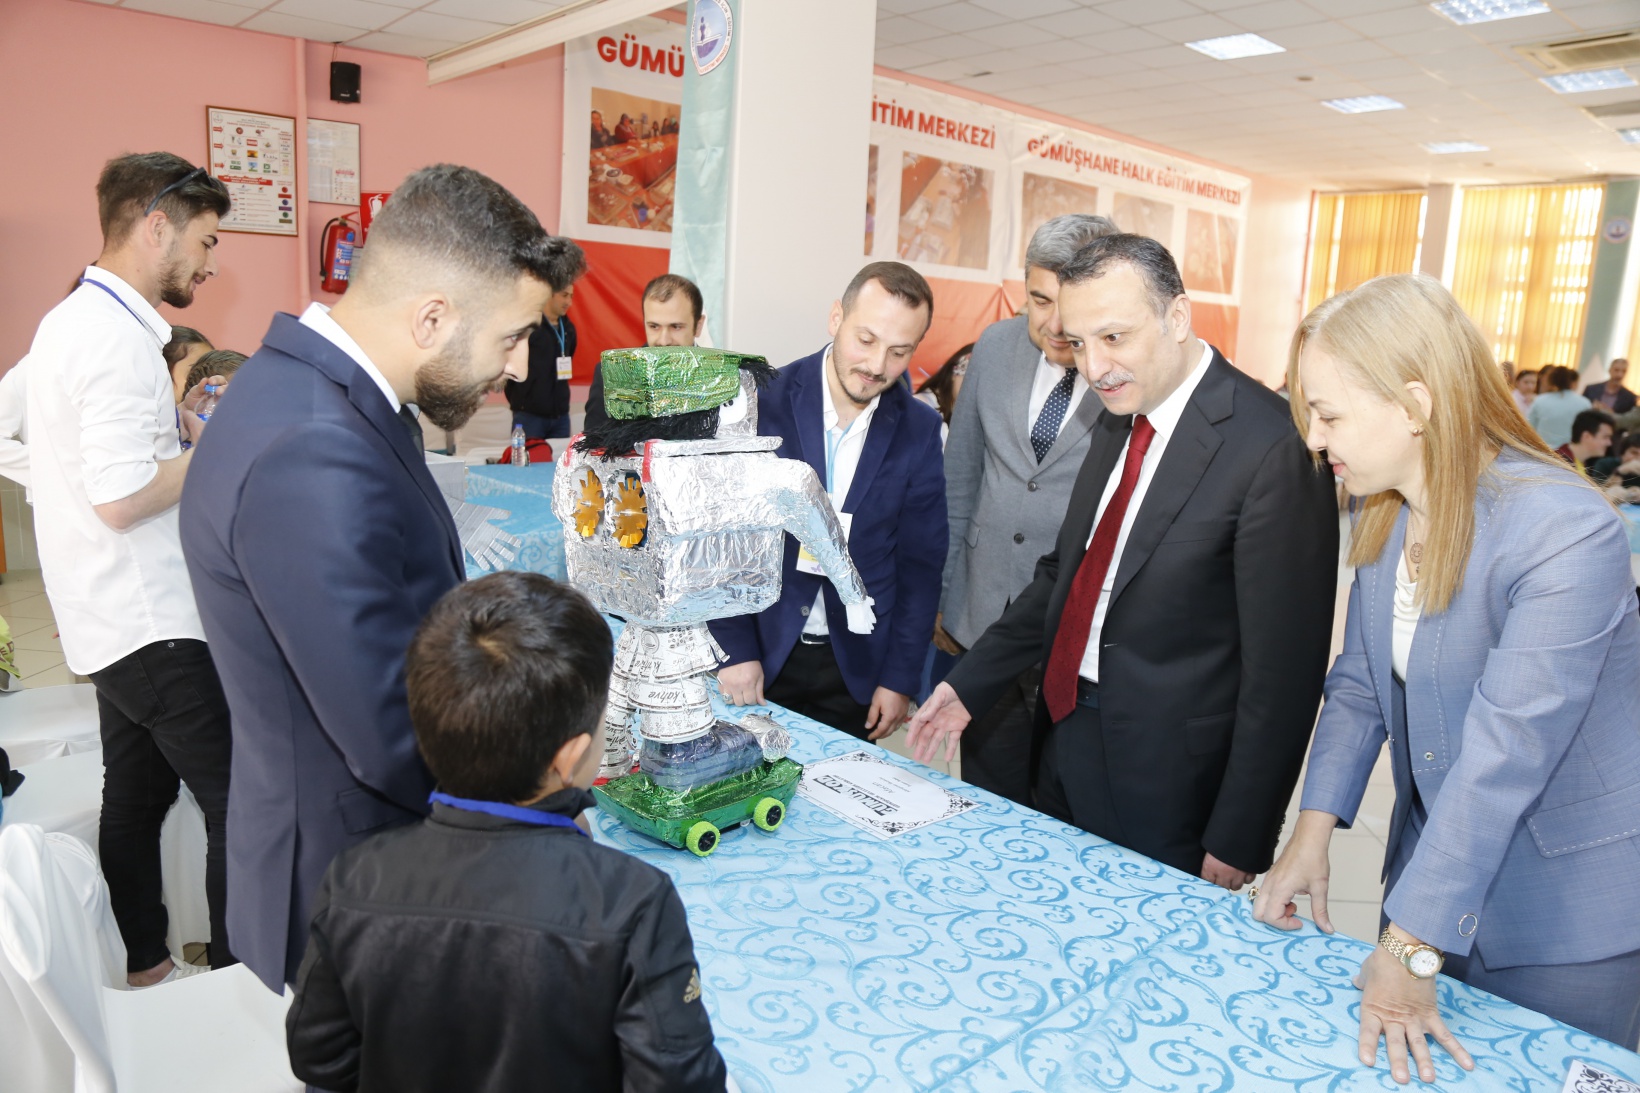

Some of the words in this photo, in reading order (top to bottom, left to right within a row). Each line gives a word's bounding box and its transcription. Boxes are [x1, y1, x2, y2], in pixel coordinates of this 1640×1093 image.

[918, 111, 996, 149] MERKEZİ
[1027, 135, 1120, 175] GÜMÜŞHANE
[1122, 163, 1154, 185] HALK
[1156, 166, 1195, 194] EĞİTİM
[648, 690, 680, 704] kahve
